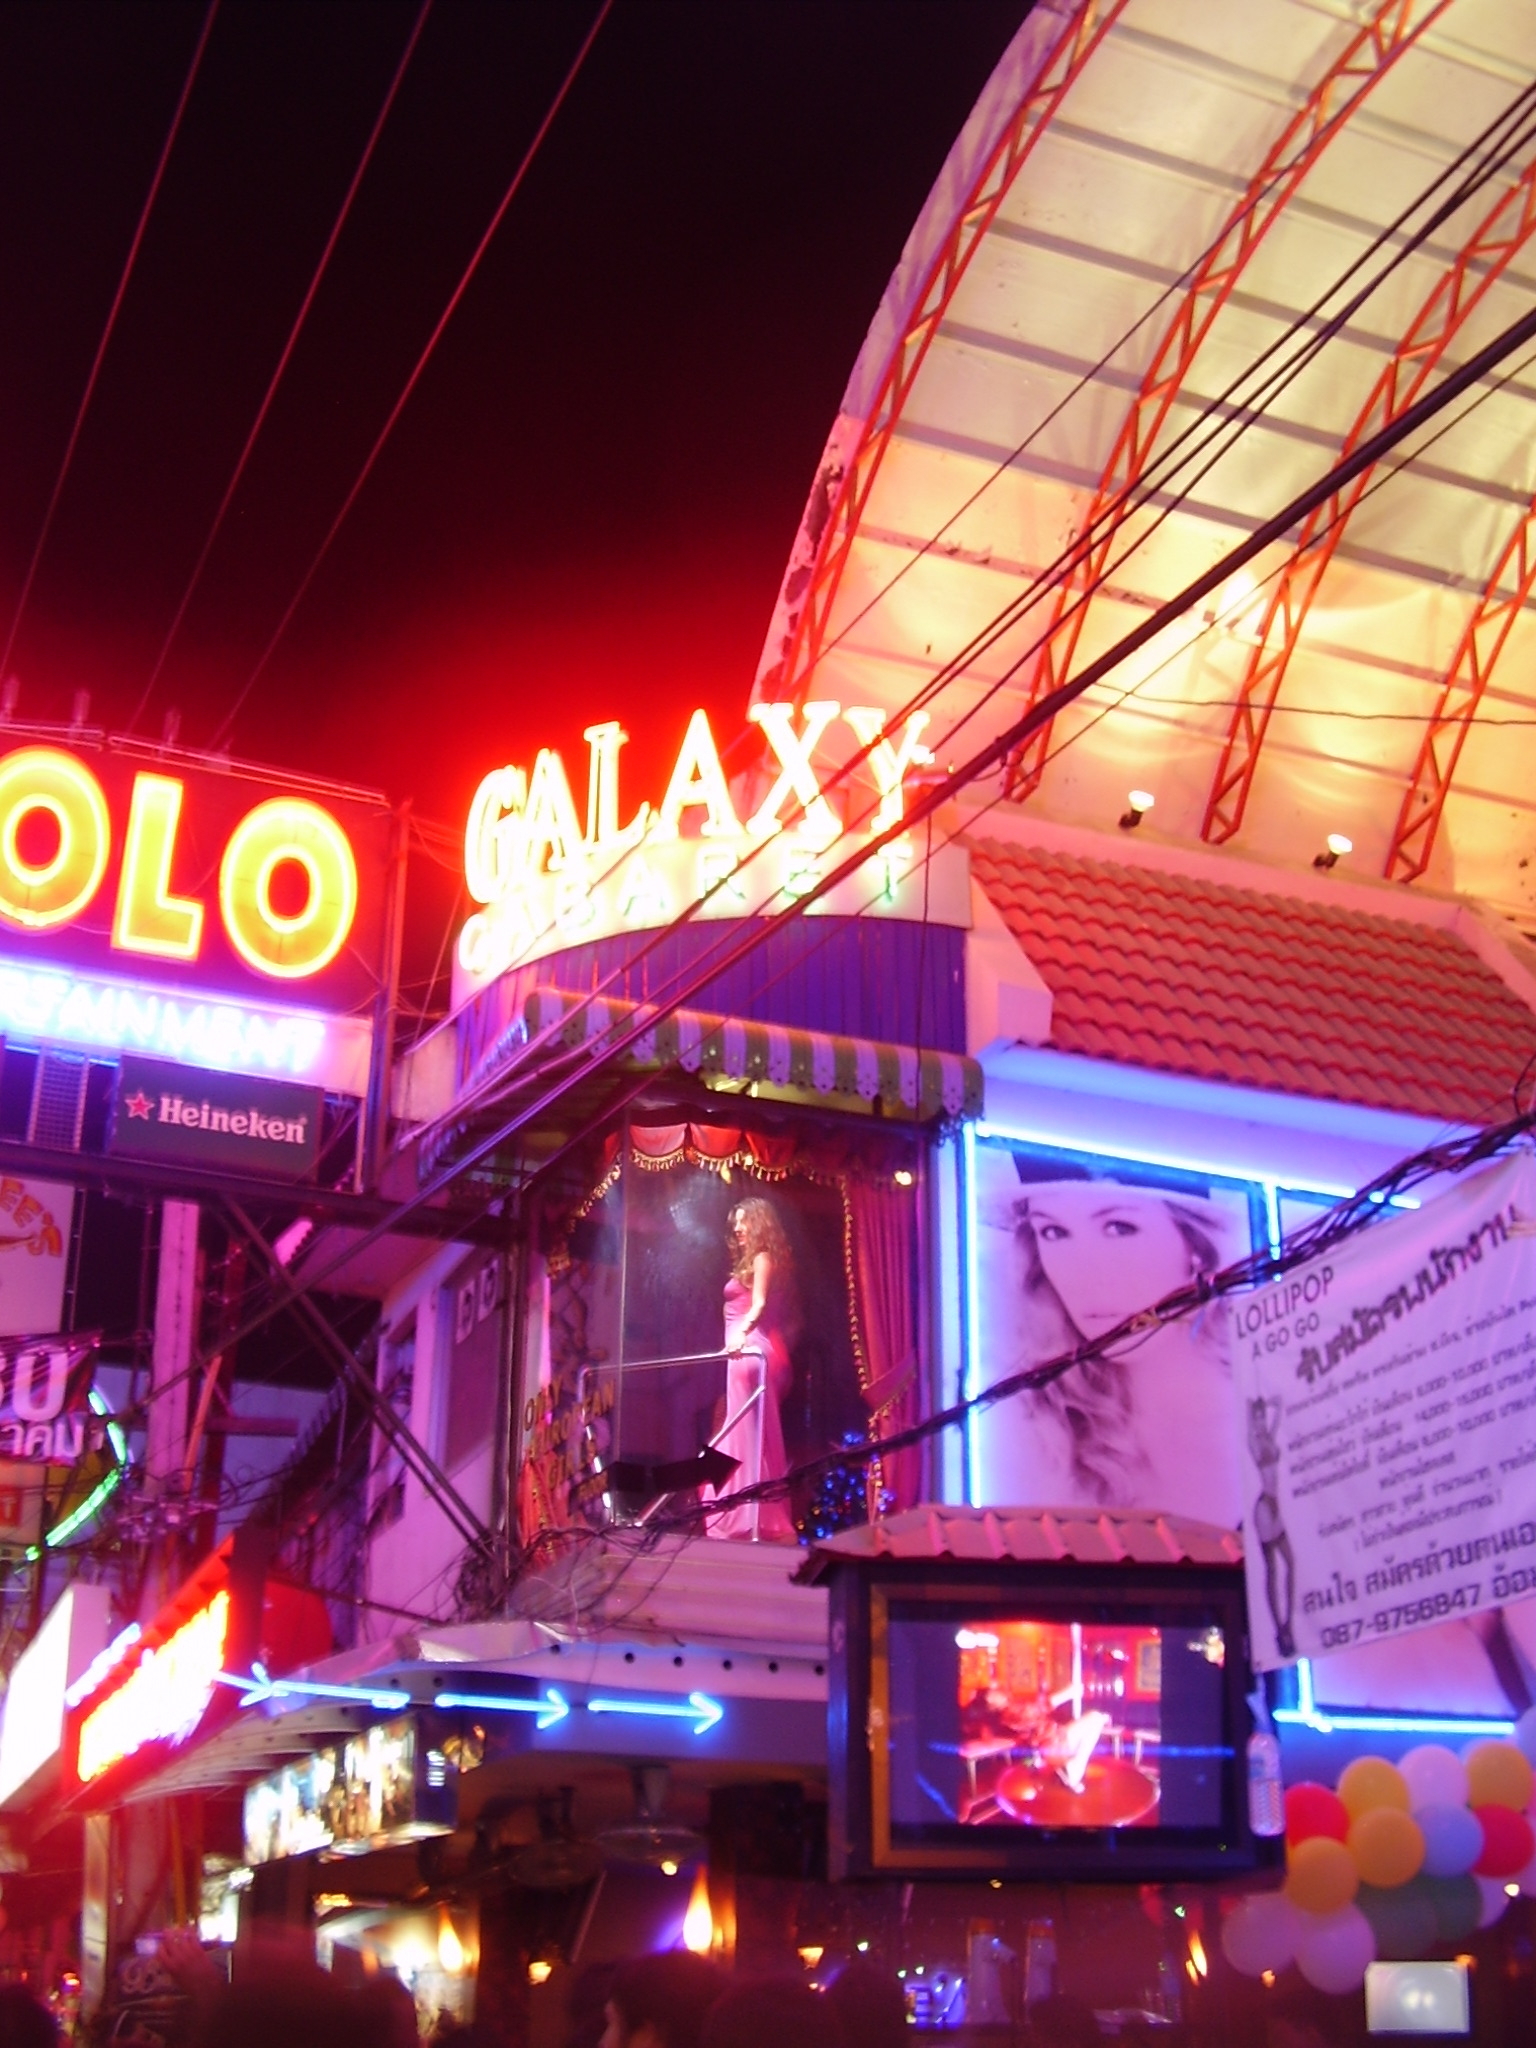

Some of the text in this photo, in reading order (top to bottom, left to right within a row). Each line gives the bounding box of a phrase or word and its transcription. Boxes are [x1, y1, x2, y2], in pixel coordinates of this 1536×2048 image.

[464, 699, 932, 904] GALAXY
[0, 746, 357, 980] OLO
[457, 840, 914, 974] CABARET
[158, 1096, 305, 1144] Heineken
[1236, 1266, 1334, 1339] LOLLIPOP
[1252, 1311, 1320, 1361] A GO GO
[1303, 1570, 1357, 1614] สนใจ
[1492, 1562, 1536, 1599] อ้อ
